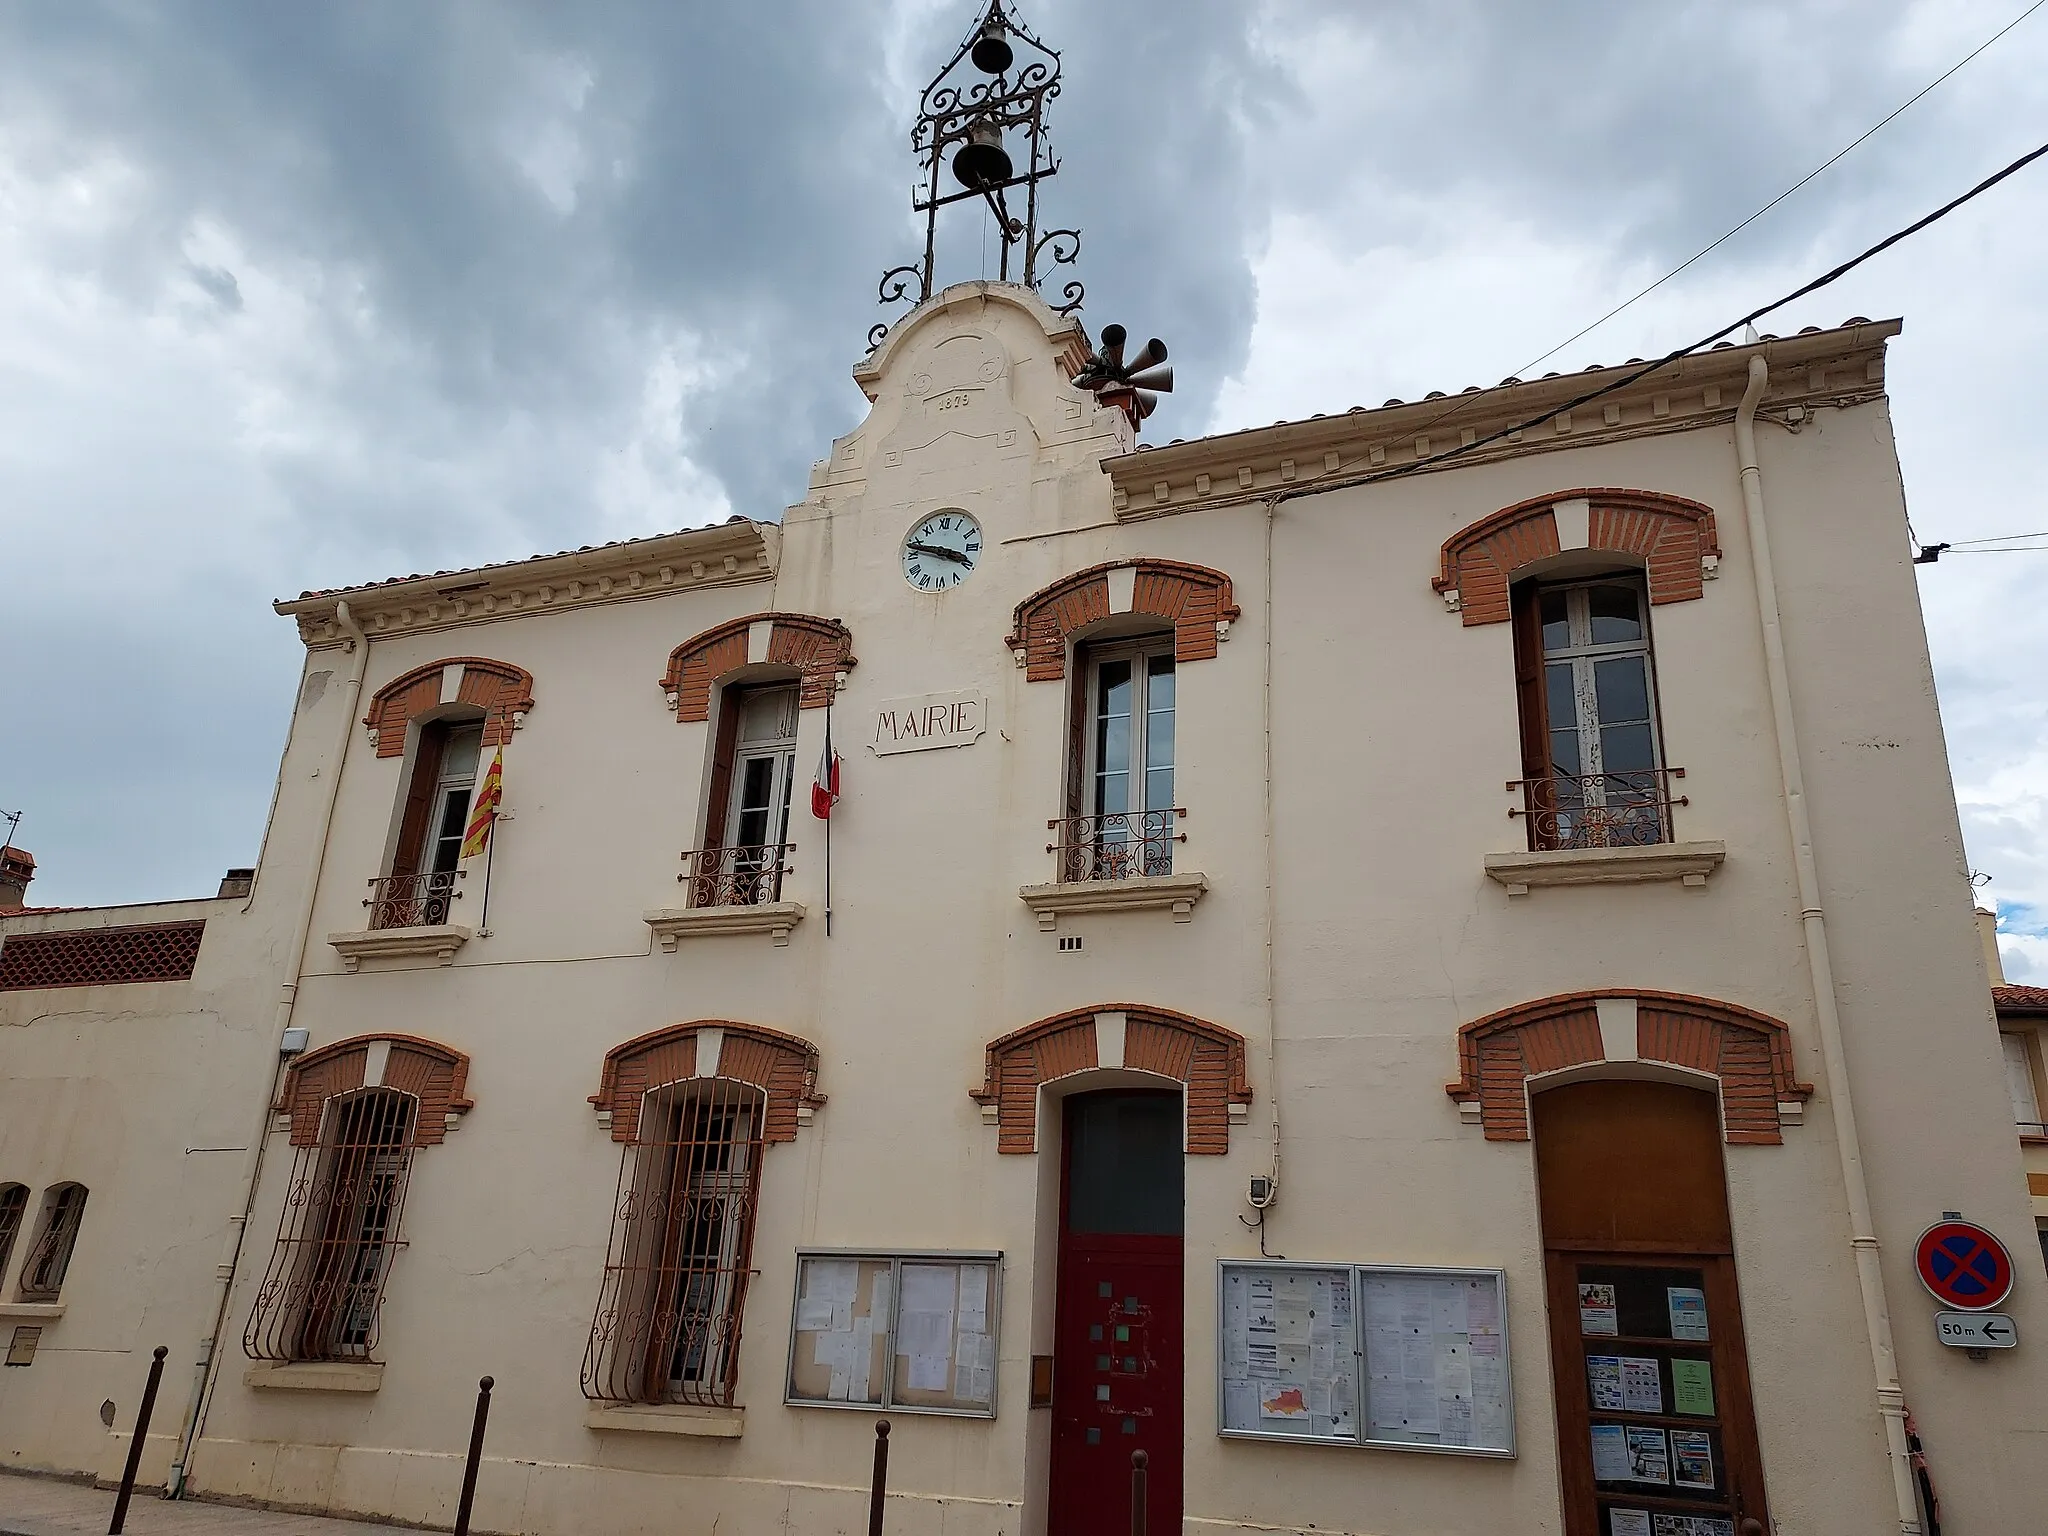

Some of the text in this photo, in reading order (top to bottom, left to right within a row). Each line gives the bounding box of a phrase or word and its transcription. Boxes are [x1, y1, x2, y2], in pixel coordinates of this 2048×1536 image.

[938, 394, 970, 411] 1879
[939, 517, 951, 530] XII
[954, 519, 963, 532] I
[922, 524, 934, 537] XI
[963, 528, 976, 540] II
[966, 542, 979, 552] III
[908, 551, 918, 561] IX
[936, 576, 946, 589] VI
[952, 572, 961, 584] V
[875, 700, 977, 743] MAIRIE
